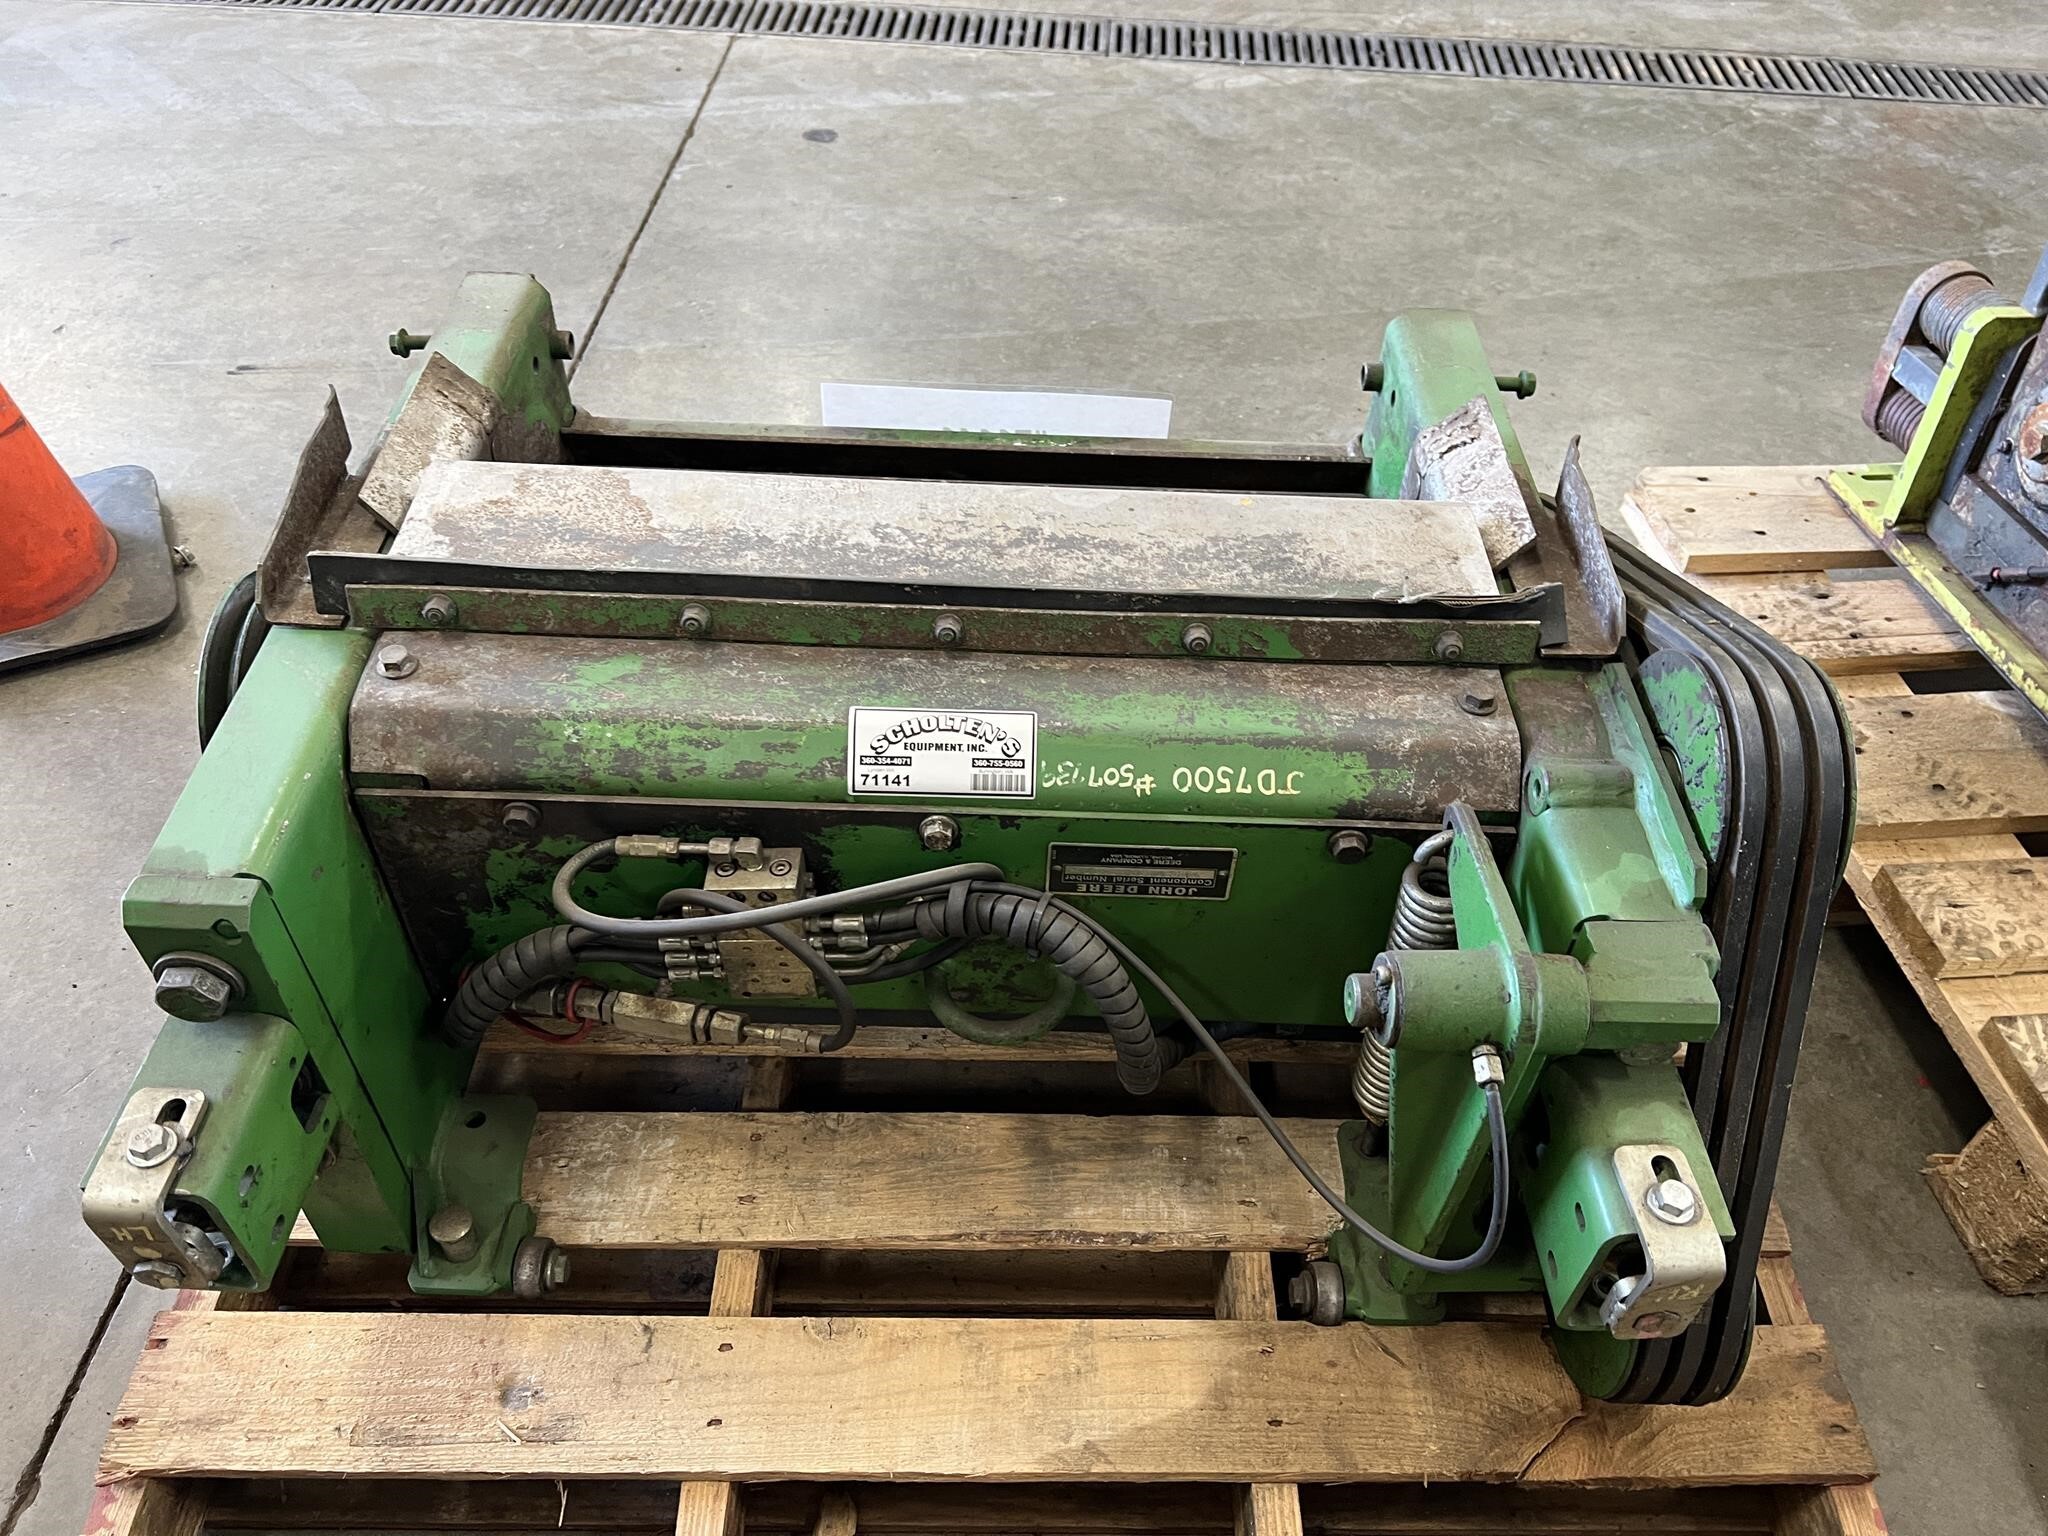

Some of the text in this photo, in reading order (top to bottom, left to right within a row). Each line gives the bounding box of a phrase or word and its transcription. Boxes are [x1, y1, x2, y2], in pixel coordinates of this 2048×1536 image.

[869, 714, 1022, 758] SCHOLTEN'S
[967, 743, 988, 753] INC.
[860, 756, 912, 766] 360-354-4071
[860, 773, 911, 787] 71141
[1172, 765, 1305, 796] JD7500
[1065, 874, 1213, 886] Component Serial Number
[1076, 883, 1198, 896] JOHN DEERE
[110, 1225, 155, 1242] LH
